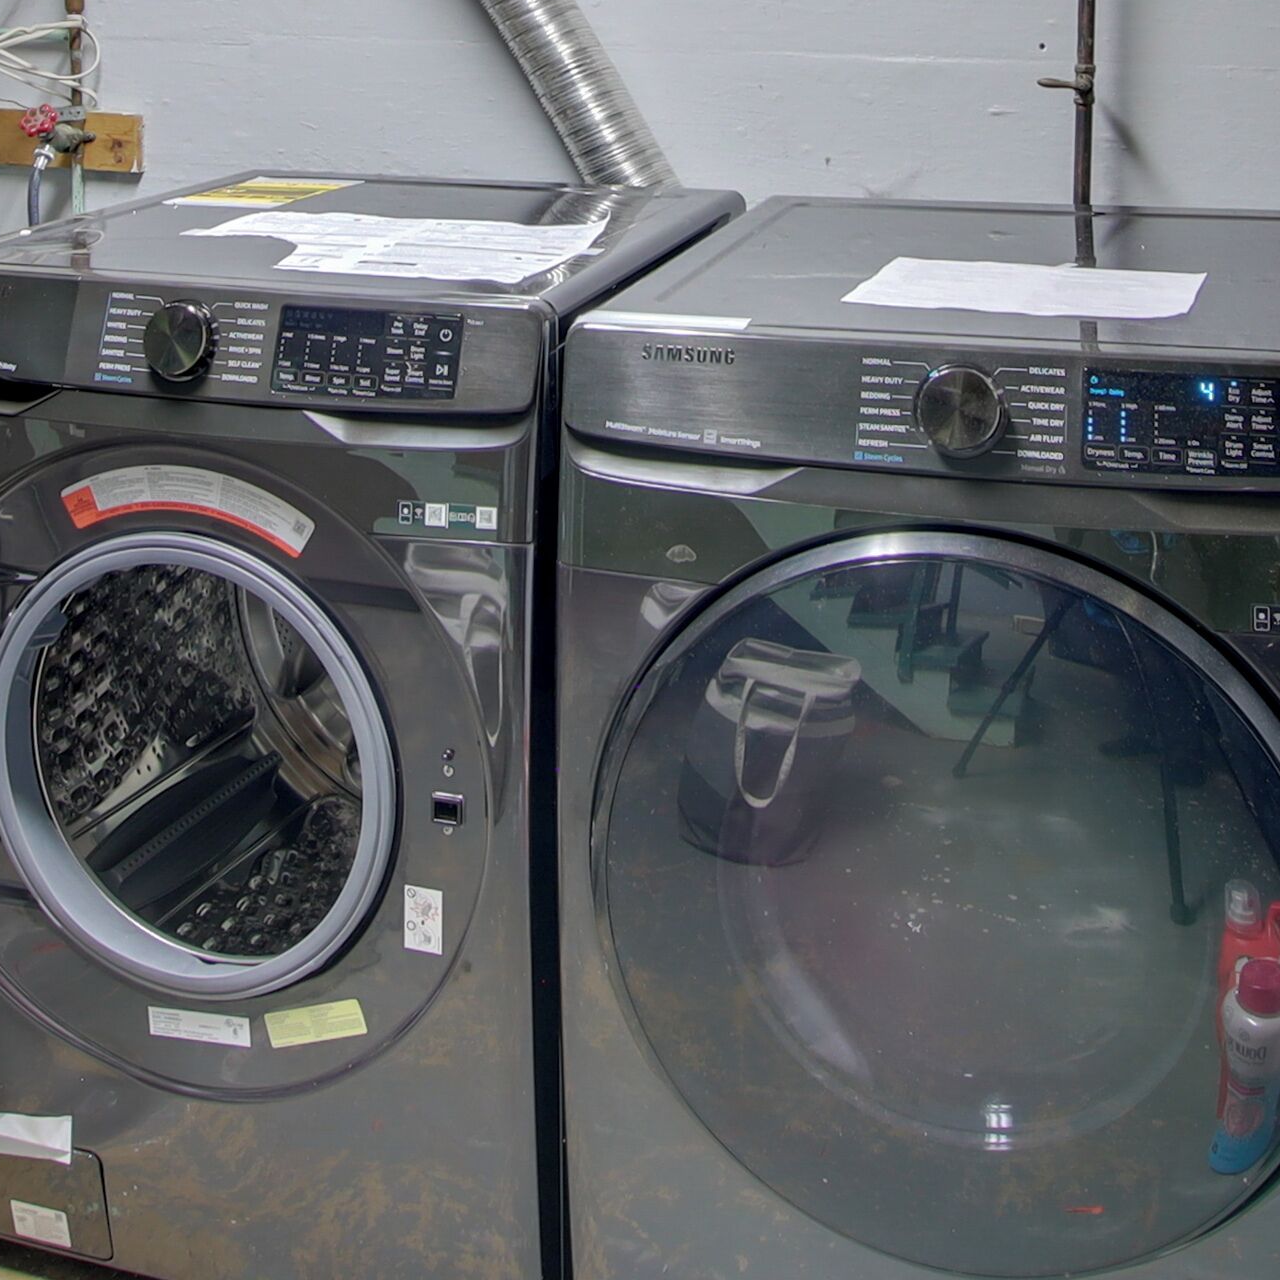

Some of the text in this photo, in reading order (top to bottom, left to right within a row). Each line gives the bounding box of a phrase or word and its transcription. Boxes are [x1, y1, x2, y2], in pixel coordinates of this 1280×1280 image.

[641, 343, 735, 365] SAMSUNG
[1028, 366, 1066, 376] DELICATES
[861, 376, 904, 384] HEAVY DUTY
[1020, 384, 1066, 395] ACTIVEWEAR
[1200, 382, 1215, 401] 4
[1251, 388, 1272, 397] Adjust
[1228, 394, 1240, 404] Dry
[1252, 396, 1267, 404] Time
[860, 406, 900, 416] PERM PRESS
[1028, 401, 1065, 412] QUICK DRY
[1032, 417, 1065, 428] TIME DRY
[1251, 416, 1272, 424] Adjust
[1252, 422, 1267, 430] Time
[1029, 434, 1064, 444] AIR FLUFF
[1252, 442, 1273, 450] Smart
[1016, 449, 1064, 460] DOWNLOADED
[1086, 447, 1115, 457] Dryness
[1158, 452, 1176, 461] Time
[1251, 450, 1275, 458] Control
